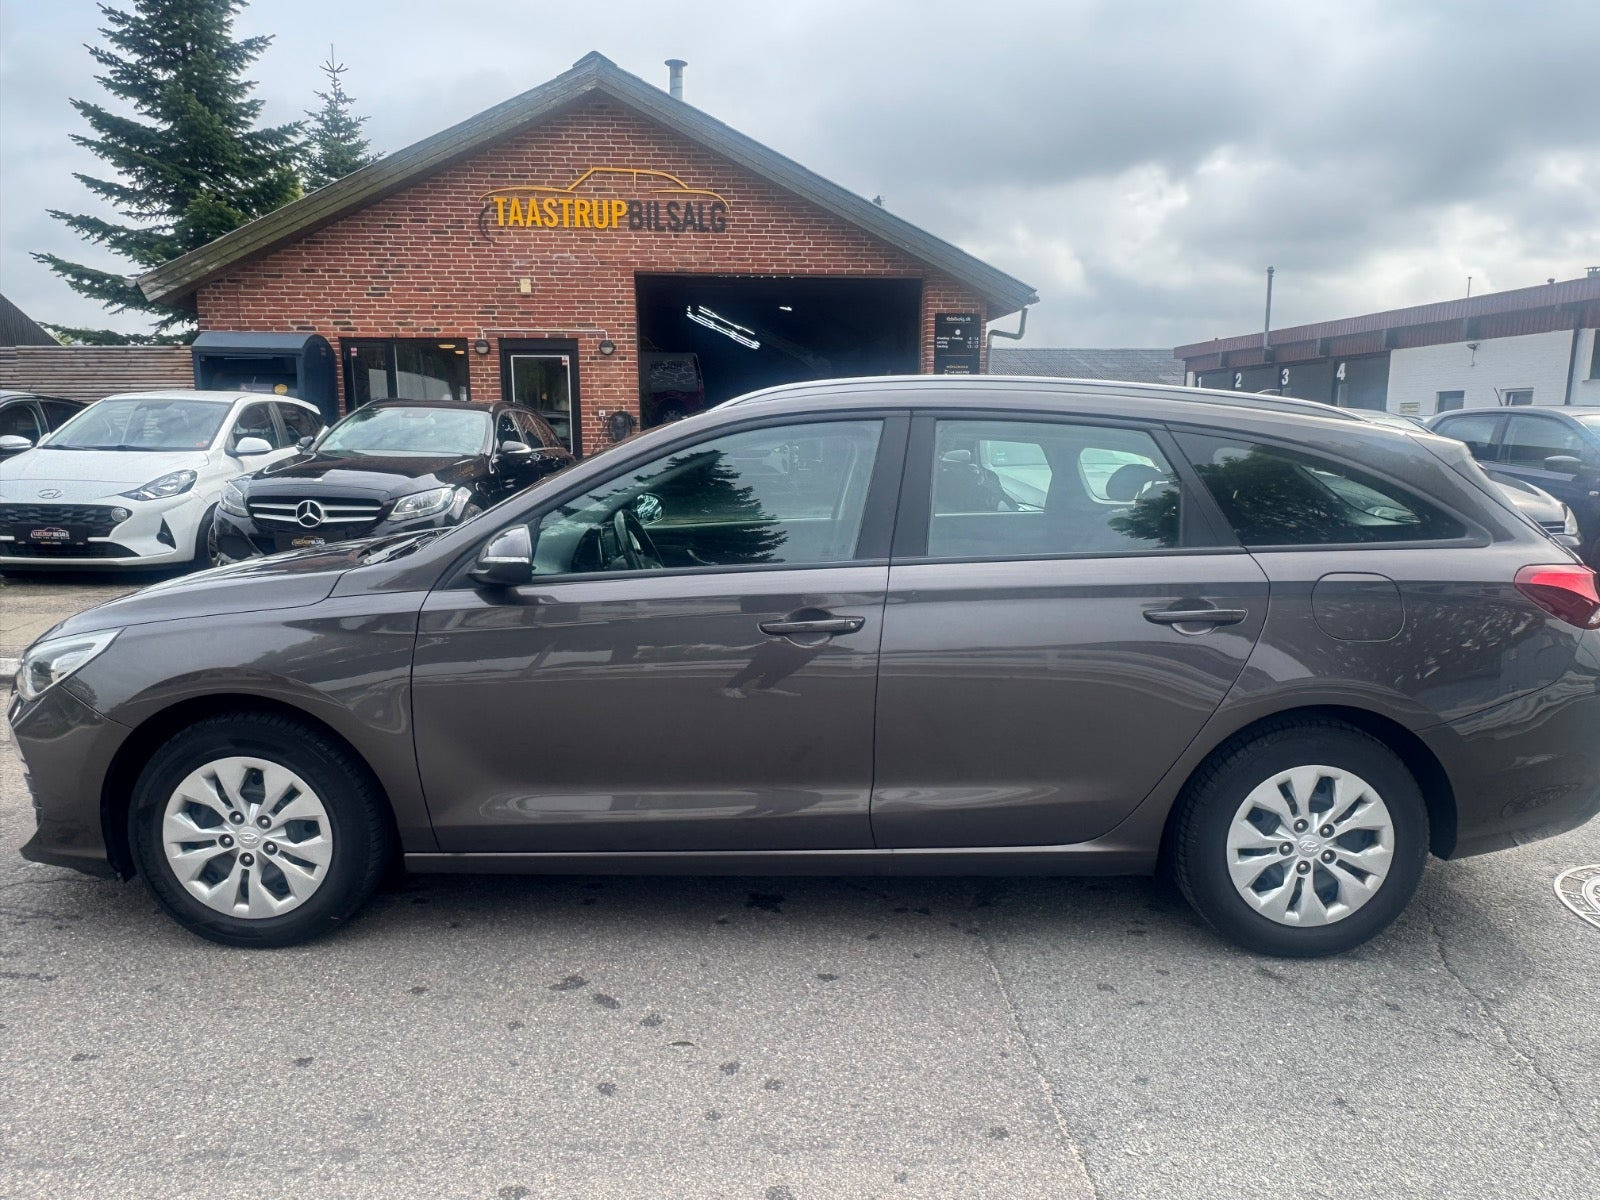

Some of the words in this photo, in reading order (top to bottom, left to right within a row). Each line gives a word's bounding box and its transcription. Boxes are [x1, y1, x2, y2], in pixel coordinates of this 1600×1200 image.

[1281, 368, 1290, 385] 3
[1336, 362, 1346, 380] 4
[1197, 376, 1203, 388] 1
[1235, 372, 1242, 388] 2
